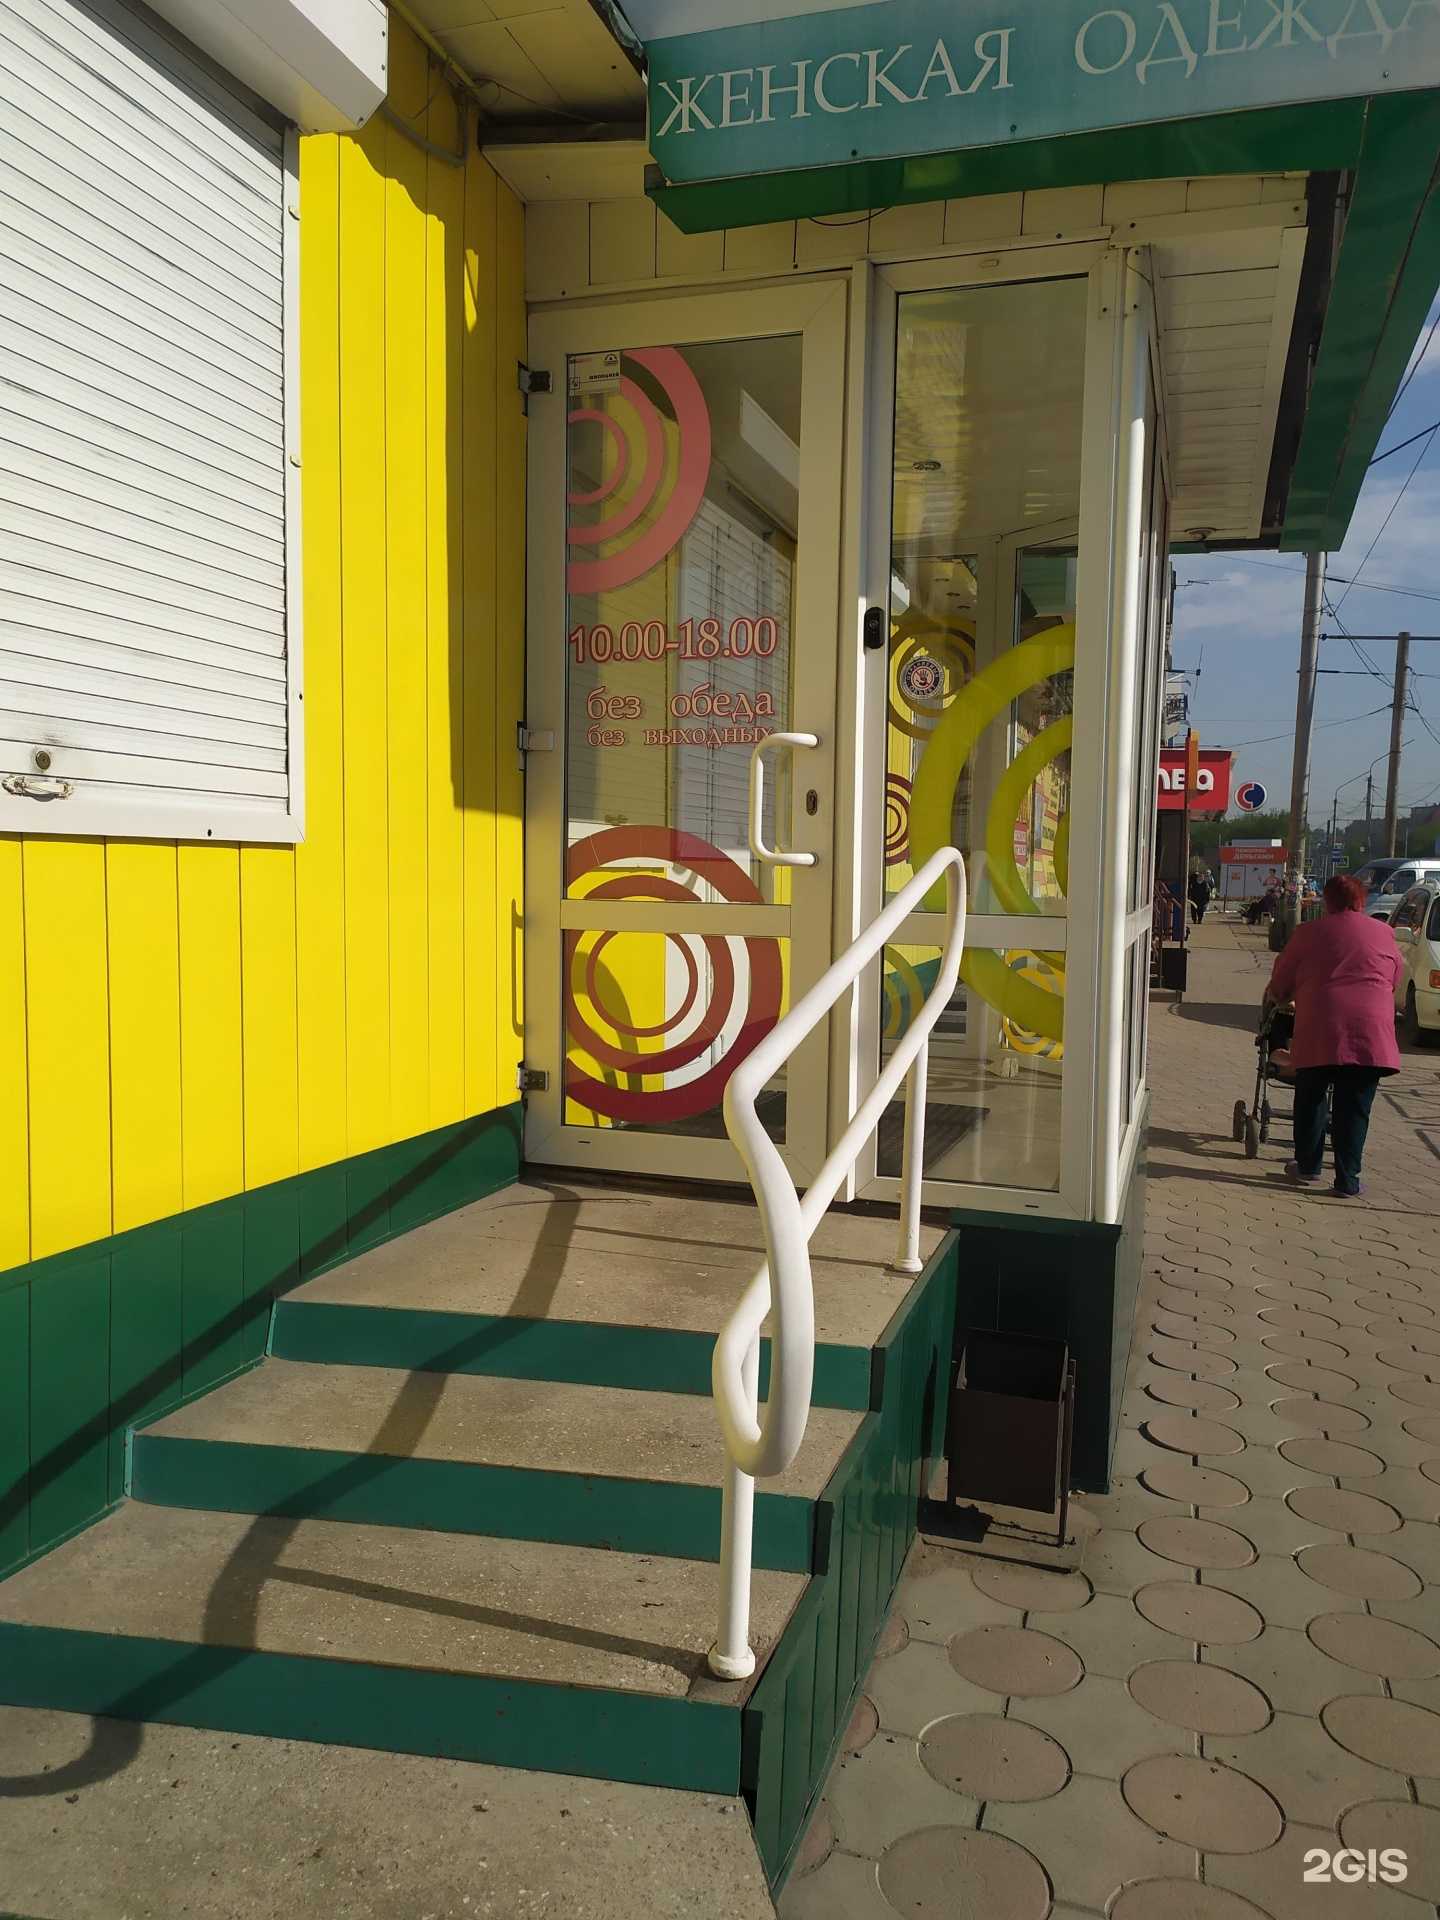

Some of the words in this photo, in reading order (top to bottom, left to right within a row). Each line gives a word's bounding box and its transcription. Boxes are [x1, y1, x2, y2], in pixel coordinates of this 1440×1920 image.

[656, 27, 1015, 136] ЖЕНСКАЯ
[569, 616, 777, 663] 10.00-18.00
[586, 685, 642, 720] без
[669, 682, 775, 723] обеда
[587, 724, 626, 746] без
